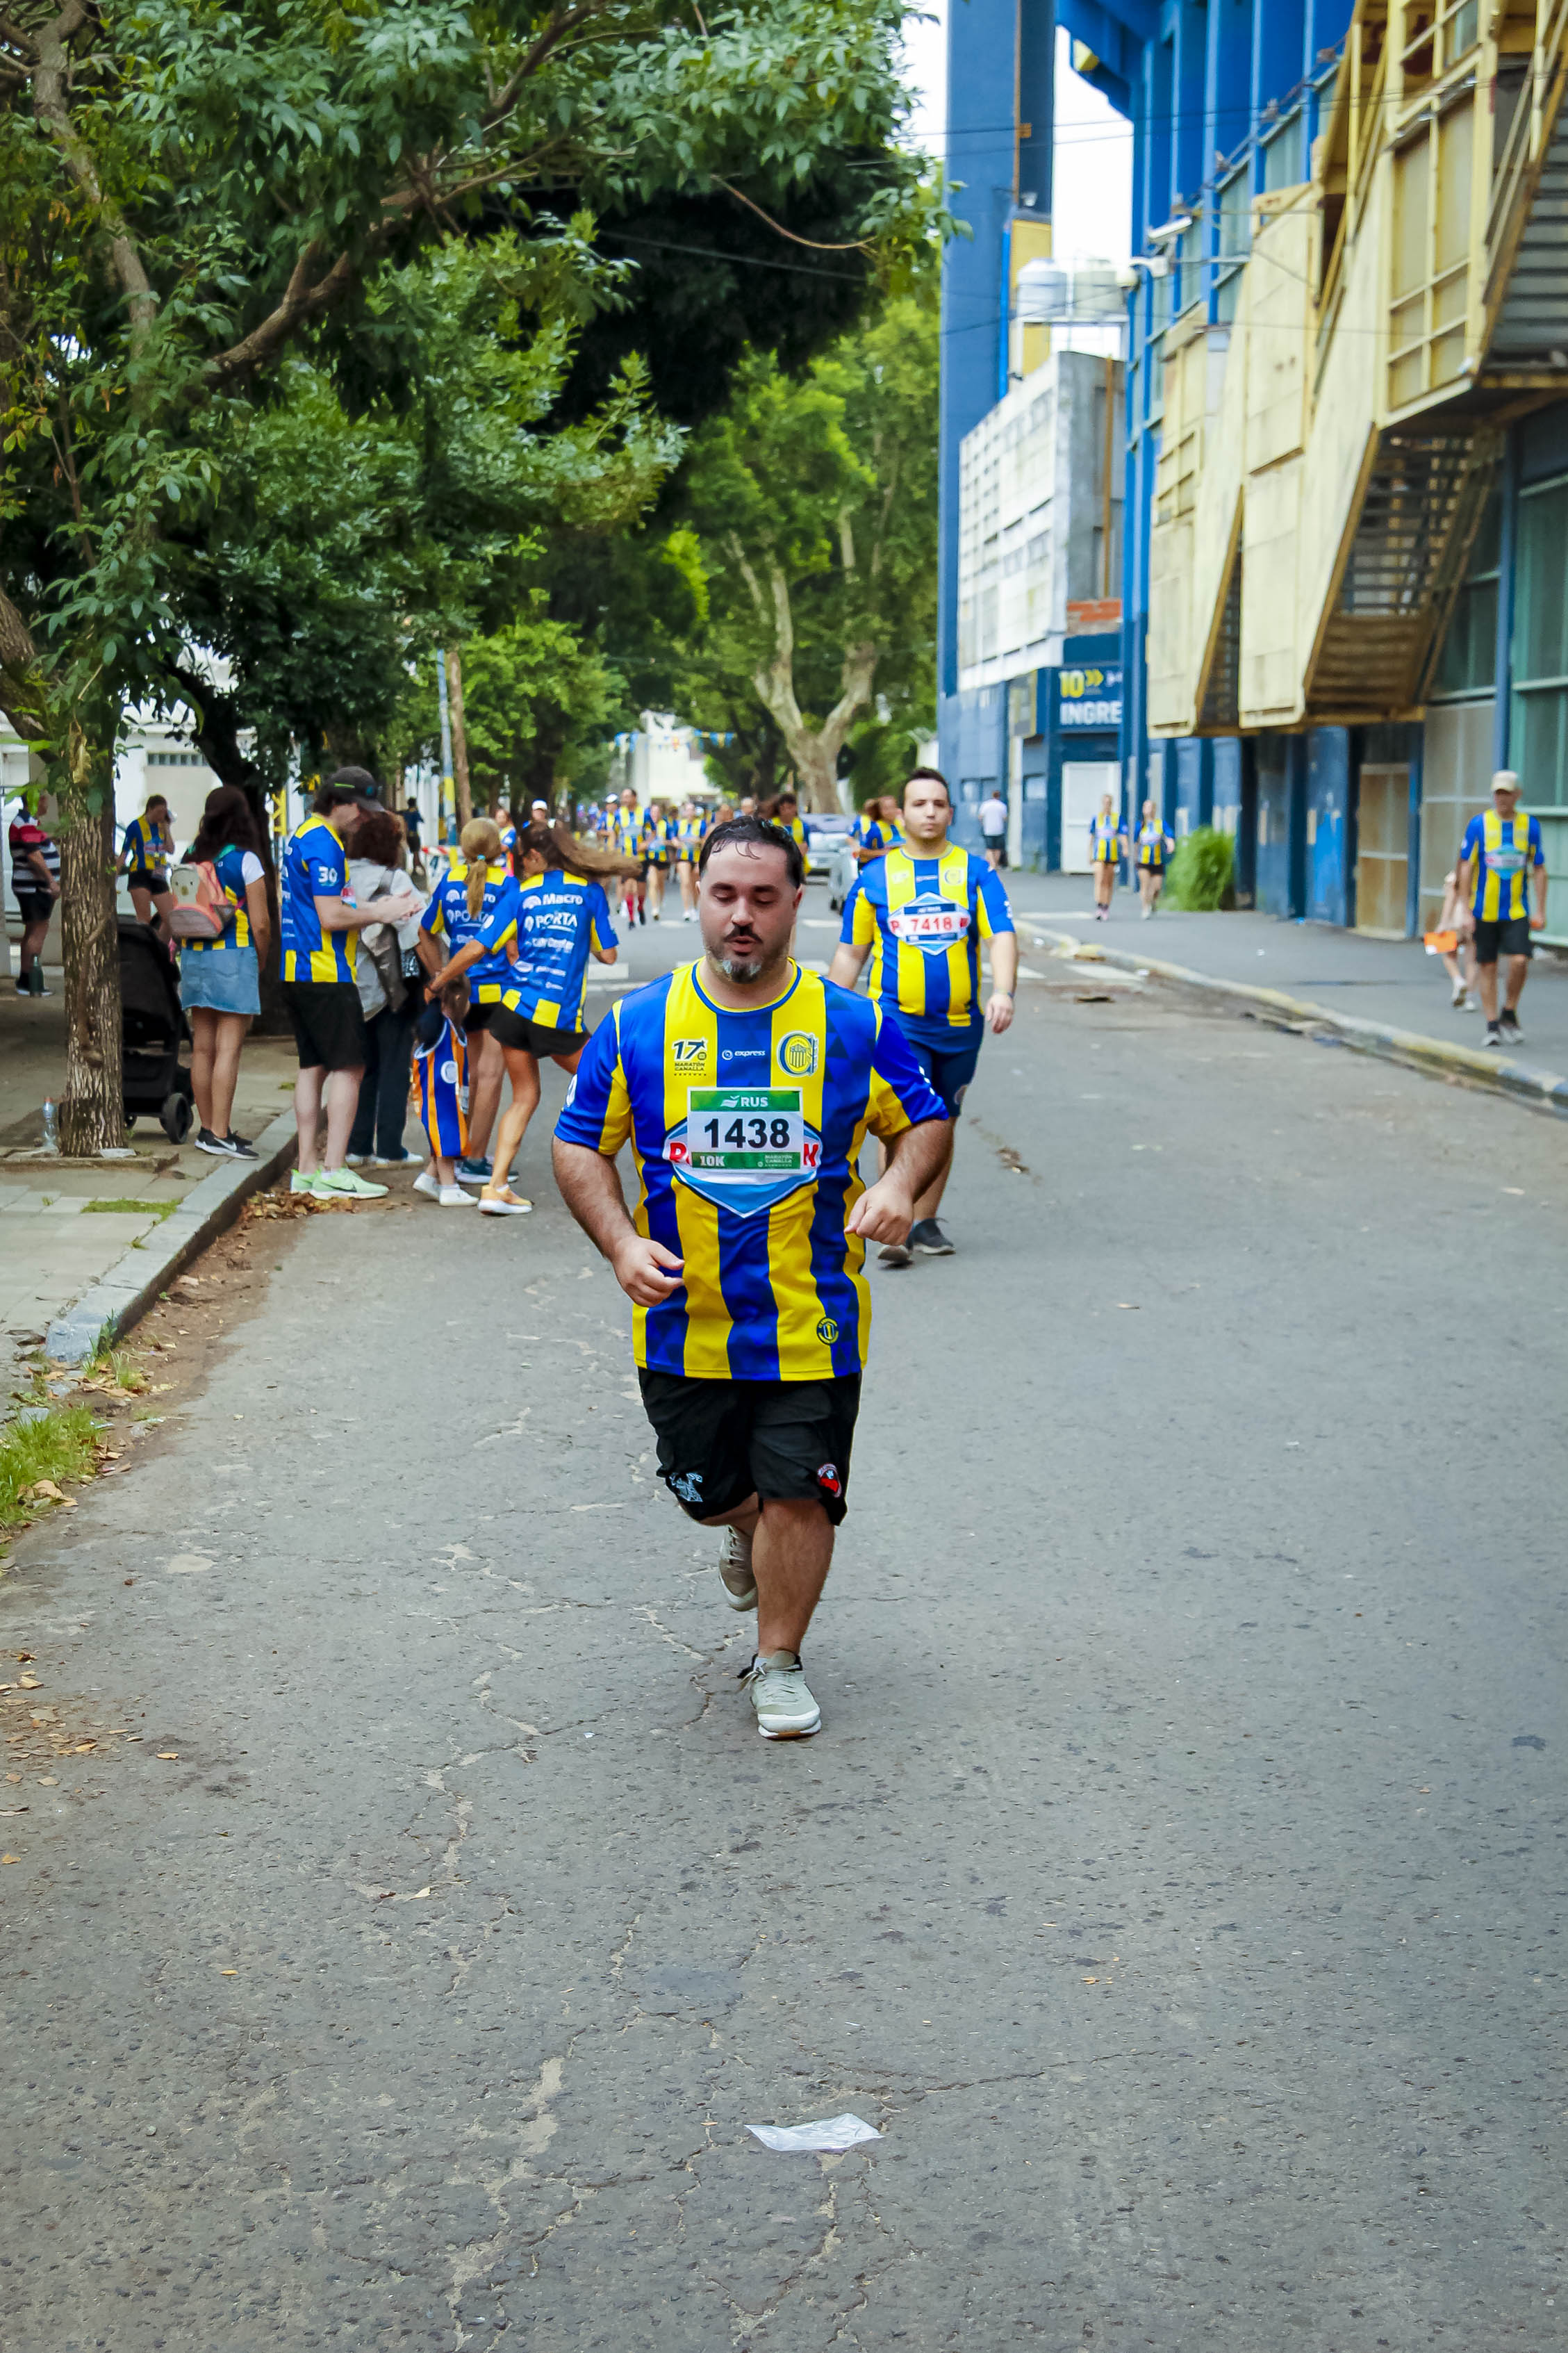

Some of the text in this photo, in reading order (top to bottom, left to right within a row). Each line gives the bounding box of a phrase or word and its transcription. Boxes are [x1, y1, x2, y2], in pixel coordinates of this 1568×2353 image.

[1059, 670, 1084, 698] 10
[318, 865, 338, 883] 30
[542, 893, 583, 905] Macro
[535, 912, 578, 928] PORTA
[910, 917, 952, 932] 7418
[672, 1039, 707, 1061] 17
[741, 1097, 768, 1107] RUS
[704, 1118, 791, 1149] 1438
[700, 1155, 726, 1167] 10K
